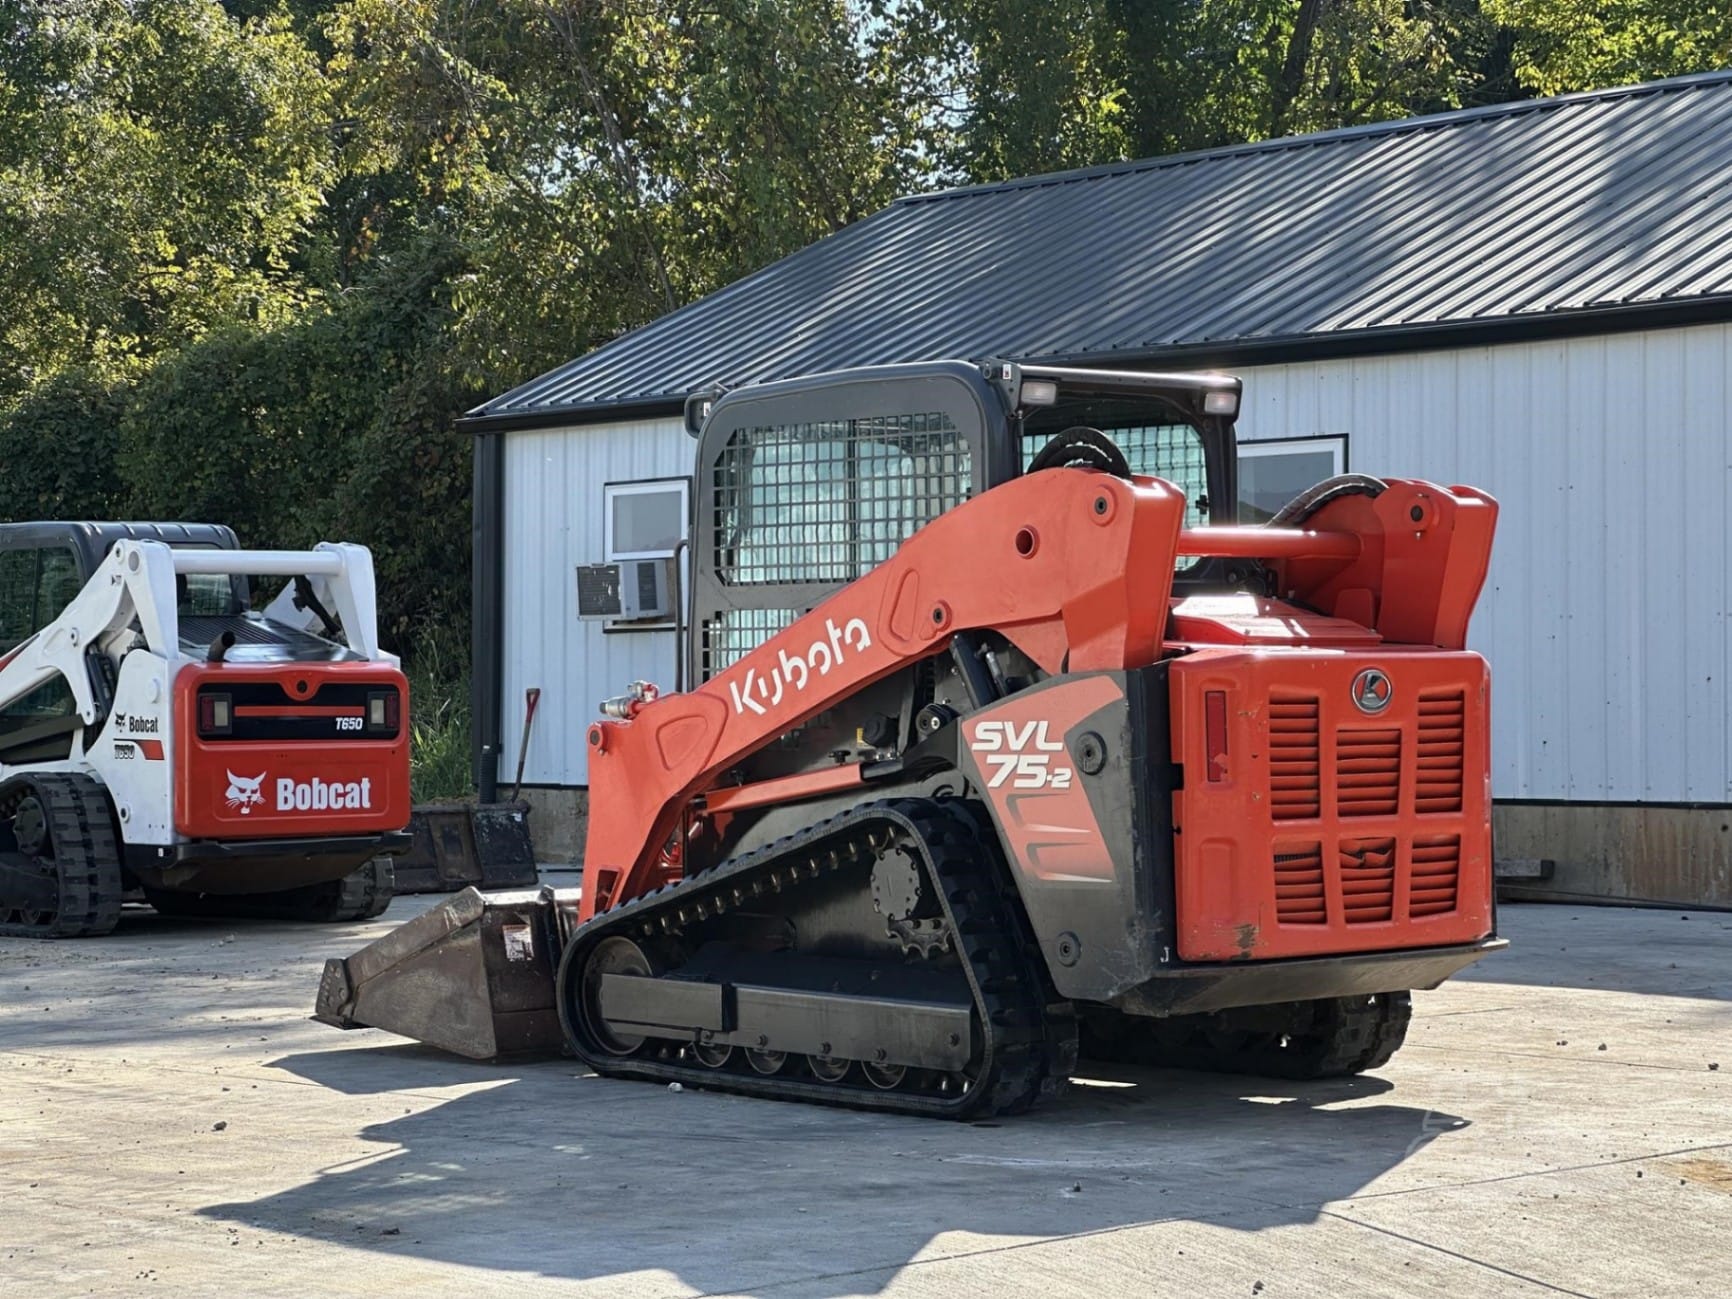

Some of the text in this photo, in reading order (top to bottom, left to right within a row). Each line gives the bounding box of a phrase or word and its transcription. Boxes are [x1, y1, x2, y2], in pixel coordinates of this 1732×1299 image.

[729, 618, 872, 716] Kubota
[129, 715, 159, 733] Bobcat
[335, 717, 363, 730] T650
[971, 720, 1065, 751] SVL
[276, 777, 371, 811] Bobcat
